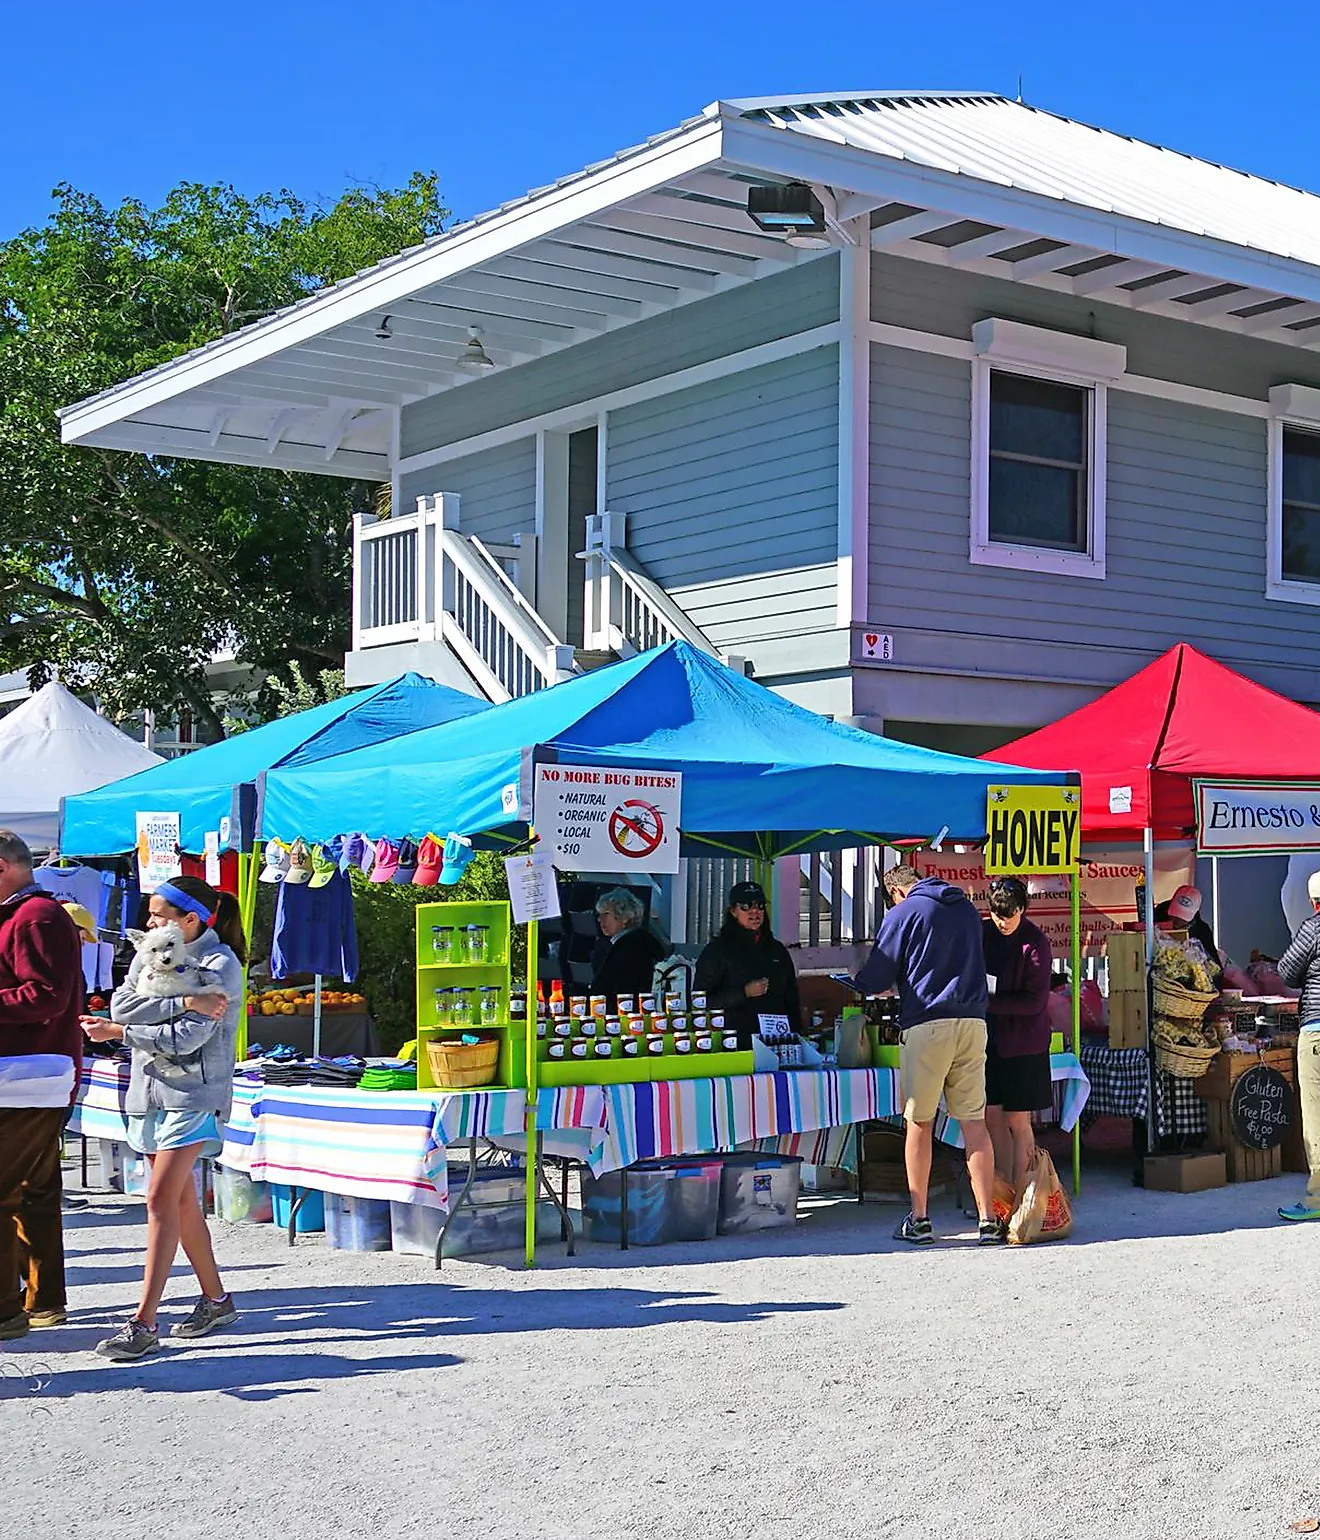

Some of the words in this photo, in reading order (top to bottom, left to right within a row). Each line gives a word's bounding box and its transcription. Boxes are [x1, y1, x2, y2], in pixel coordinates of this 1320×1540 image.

[542, 770, 560, 781] NO
[563, 771, 601, 784] MORE
[604, 774, 630, 786] BUG
[634, 775, 676, 789] BITES!
[564, 792, 607, 806] NATURAL
[564, 810, 607, 823] ORGANIC
[1209, 801, 1305, 829] Ernesto
[563, 826, 591, 839] LOCAL
[990, 809, 1078, 867] HONEY
[562, 843, 580, 855] $10
[924, 864, 989, 881] Ernest
[1245, 1074, 1283, 1098] Gluten
[1238, 1096, 1259, 1119] Free
[1259, 1100, 1290, 1125] Pasta
